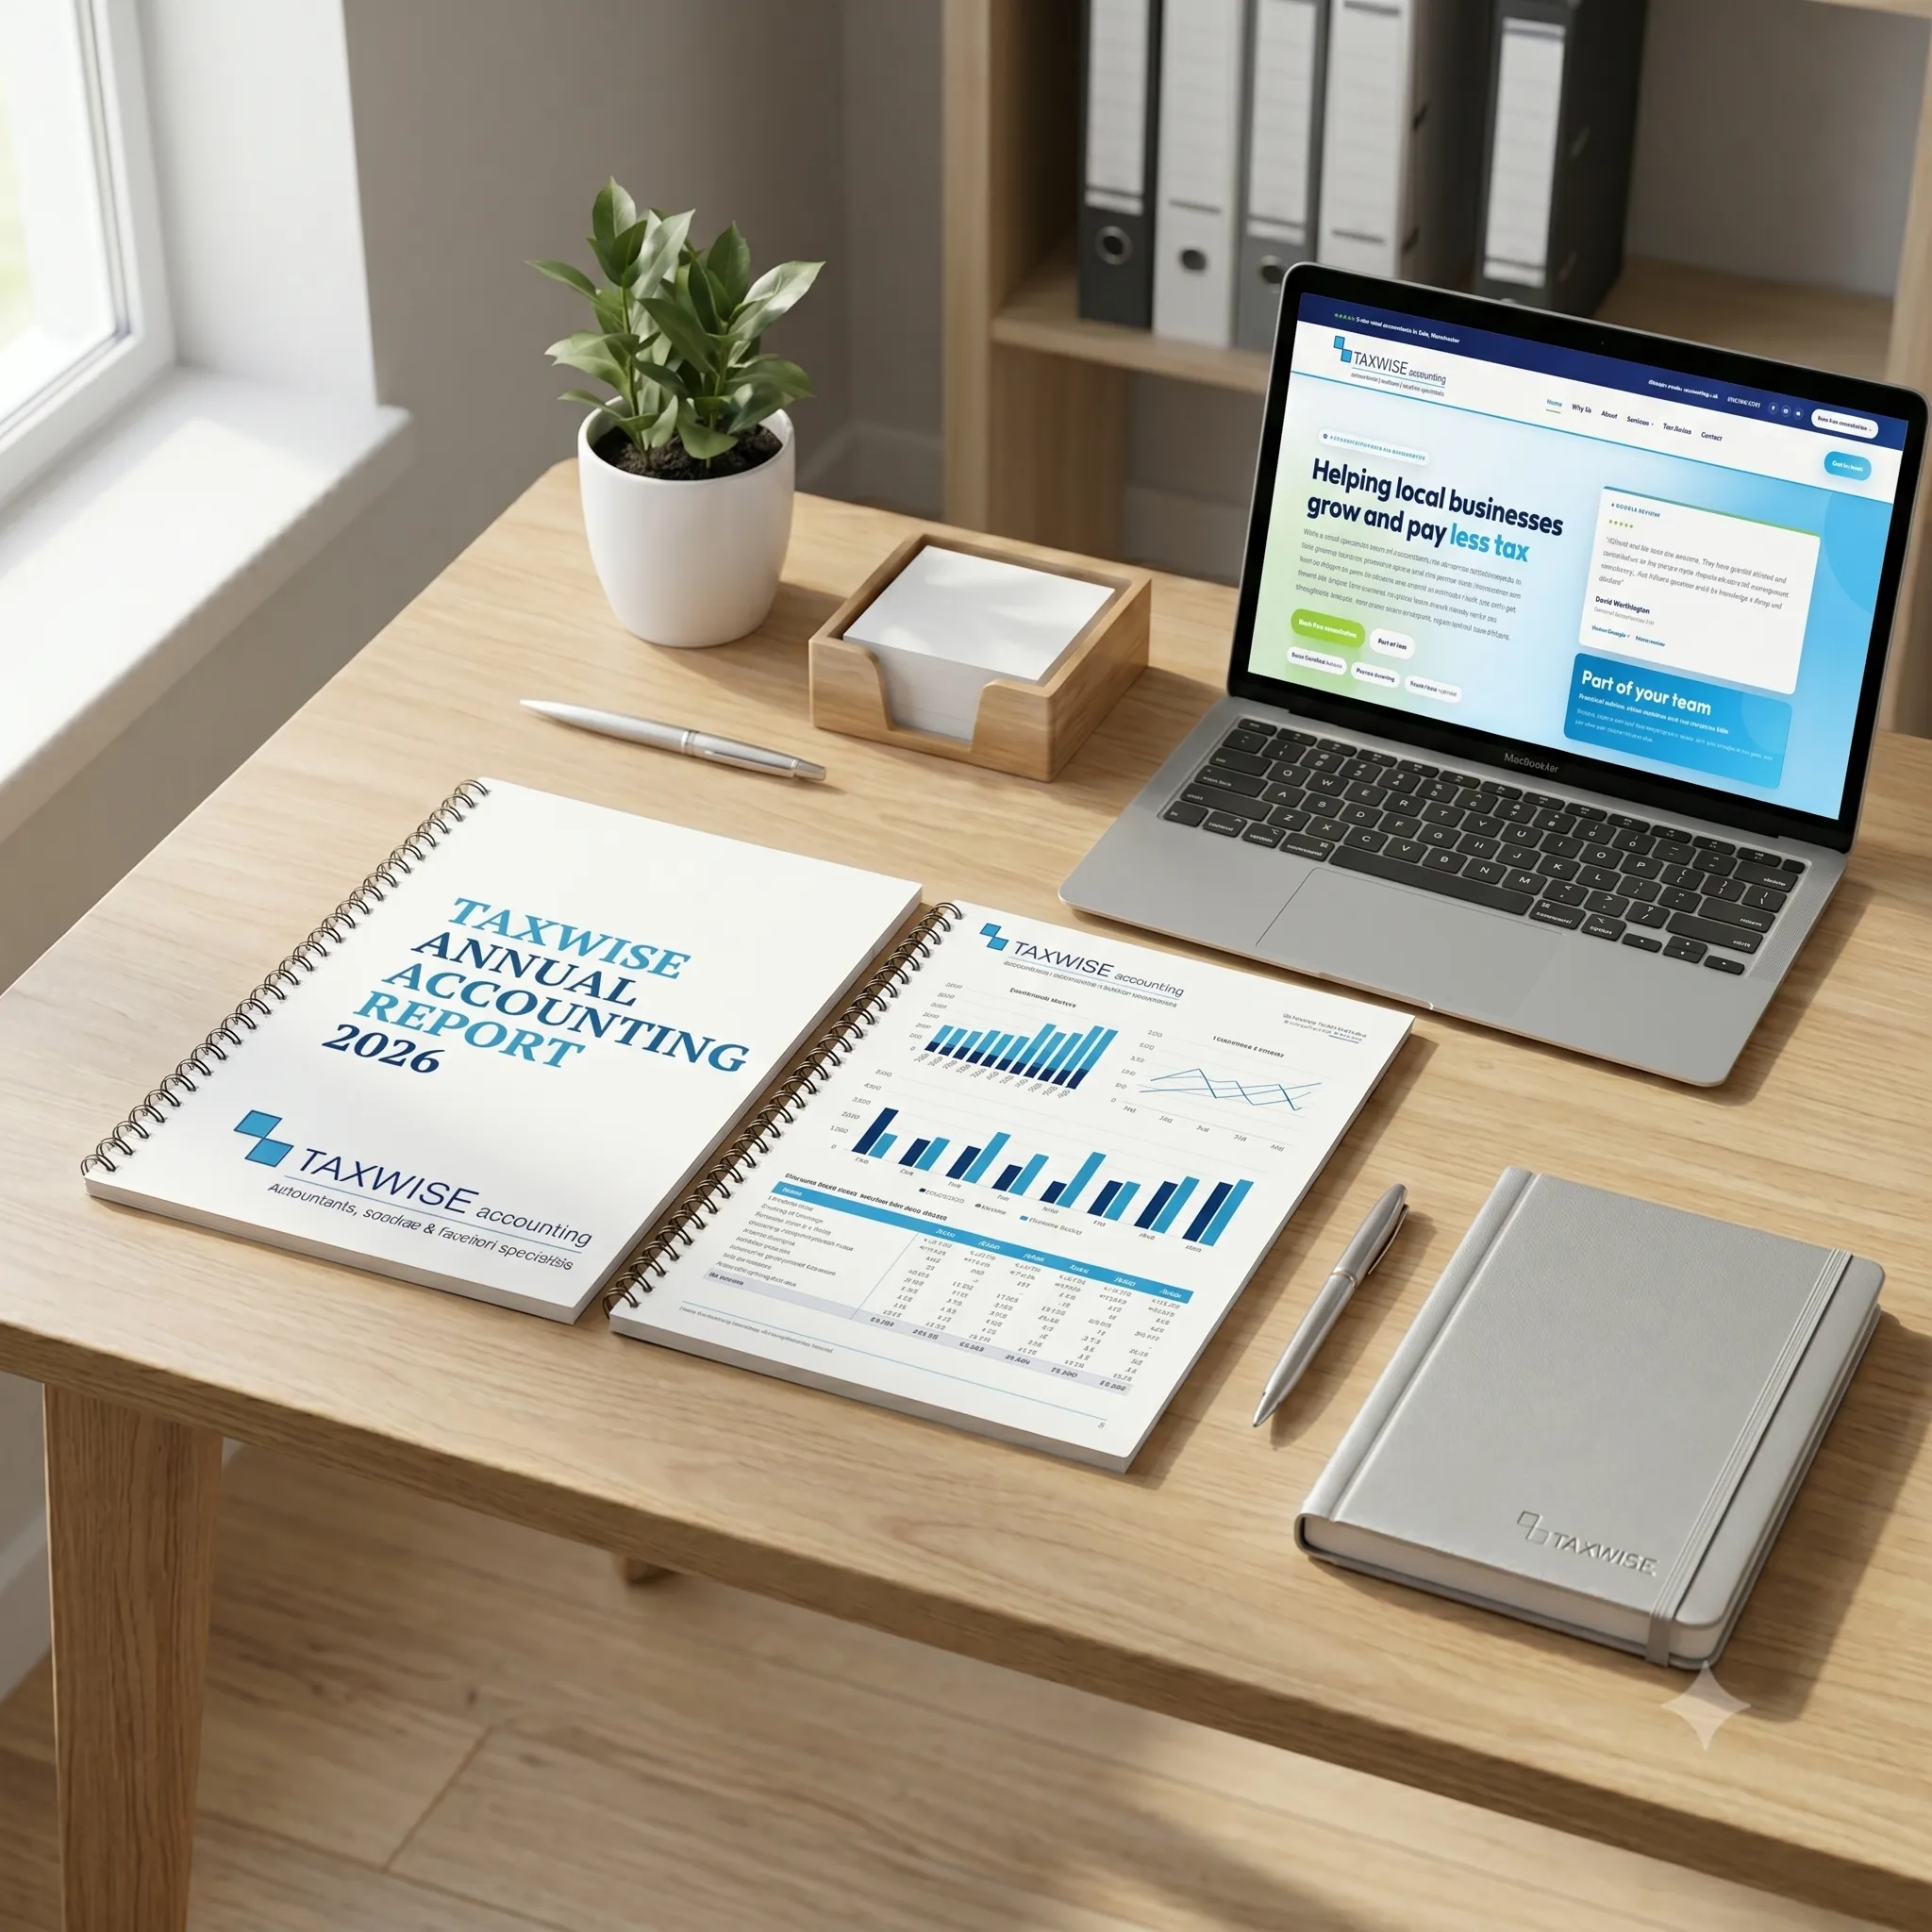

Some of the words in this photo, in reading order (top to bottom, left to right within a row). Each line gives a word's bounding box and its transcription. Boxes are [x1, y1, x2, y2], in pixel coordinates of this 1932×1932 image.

[1354, 351, 1408, 375] TAXWISE
[1312, 458, 1391, 502] Helping
[1395, 476, 1446, 508] local
[1449, 489, 1563, 536] businesses
[1307, 496, 1361, 522] grow
[1364, 509, 1405, 533] and
[1407, 519, 1447, 548] pay
[1450, 523, 1491, 553] less
[1494, 534, 1530, 562] tax
[1595, 595, 1612, 606] David
[1582, 670, 1614, 691] Part
[1616, 681, 1634, 695] of
[1635, 687, 1670, 705] your
[1673, 693, 1711, 716] team
[448, 897, 691, 979] TAXWISE
[410, 932, 637, 1007] ANNUAL
[1015, 941, 1114, 977] TAXWISE
[1114, 974, 1184, 998] accounting
[353, 991, 586, 1068] REPORT
[381, 963, 750, 1072] ACCOUNTING
[322, 1024, 445, 1073] 2026
[300, 1148, 479, 1214] TAXWISE
[476, 1208, 592, 1248] accounting
[424, 1224, 436, 1234] &
[1554, 1532, 1657, 1576] TAXWISE
